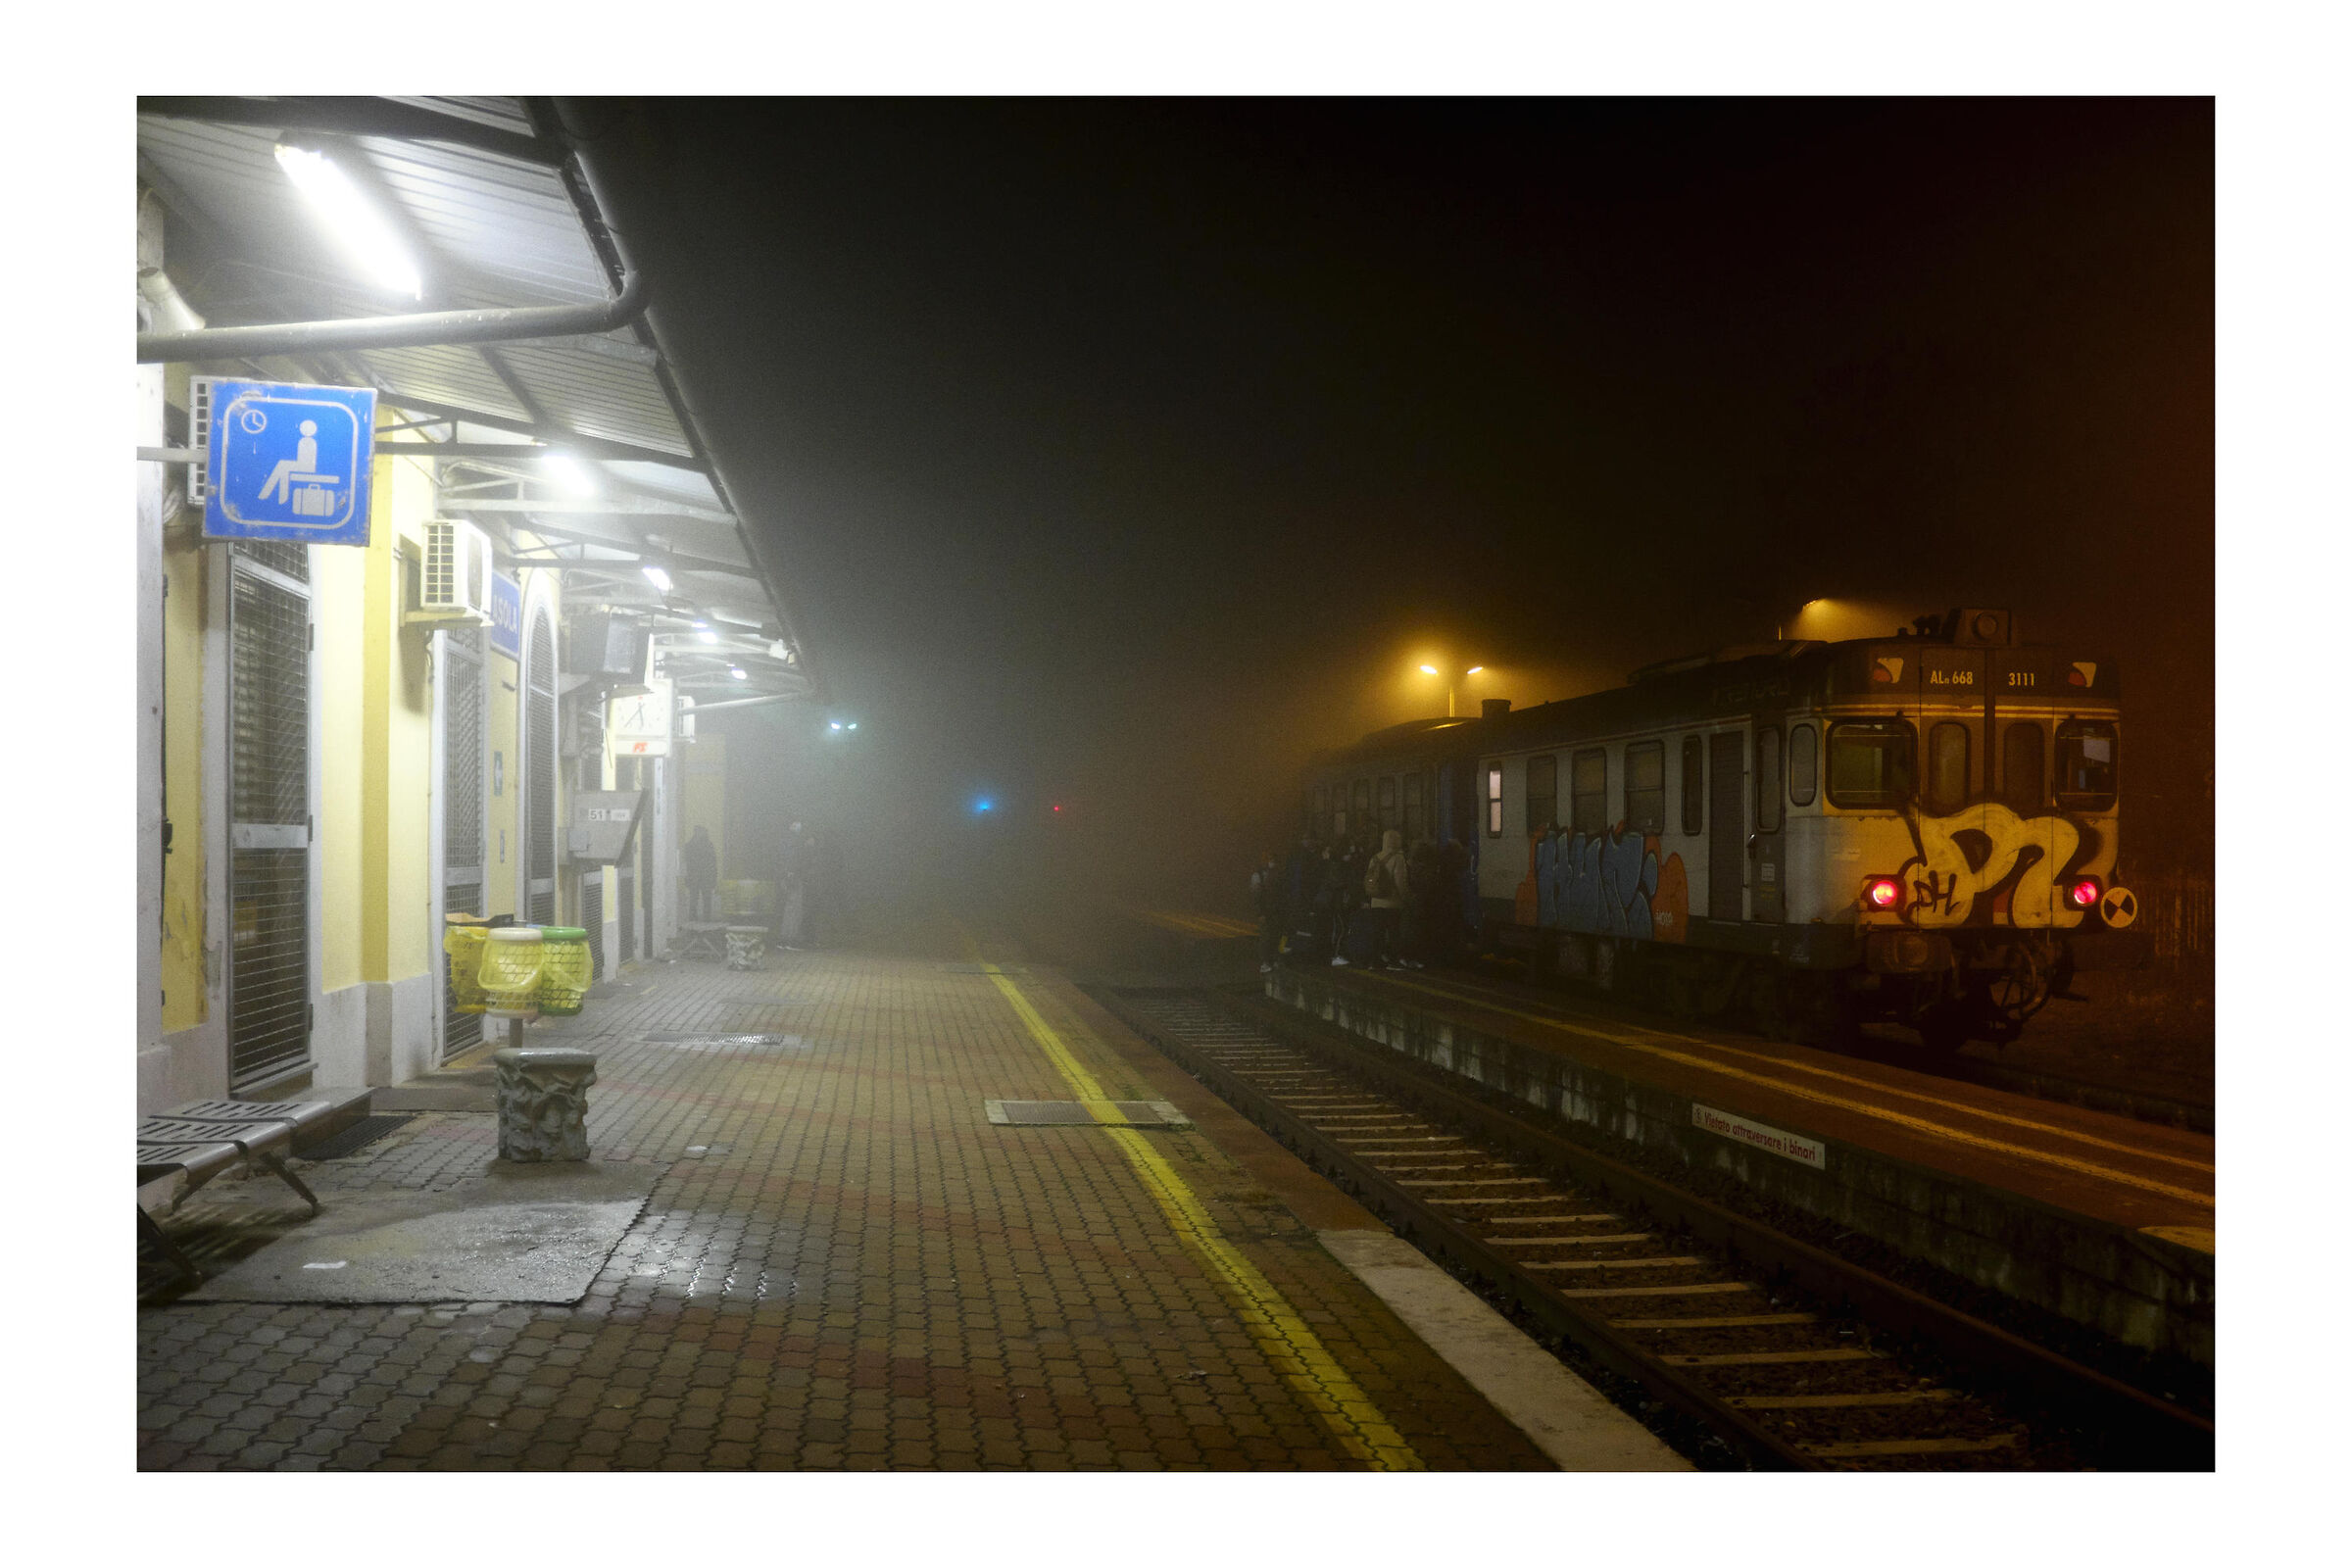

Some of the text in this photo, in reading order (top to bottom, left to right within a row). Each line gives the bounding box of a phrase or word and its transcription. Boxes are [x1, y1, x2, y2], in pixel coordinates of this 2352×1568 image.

[1952, 670, 1973, 685] 668
[2008, 672, 2035, 686] 3111
[1705, 1111, 1730, 1132] Vietato
[1732, 1124, 1781, 1150] attraversare
[1789, 1139, 1815, 1161] binari
